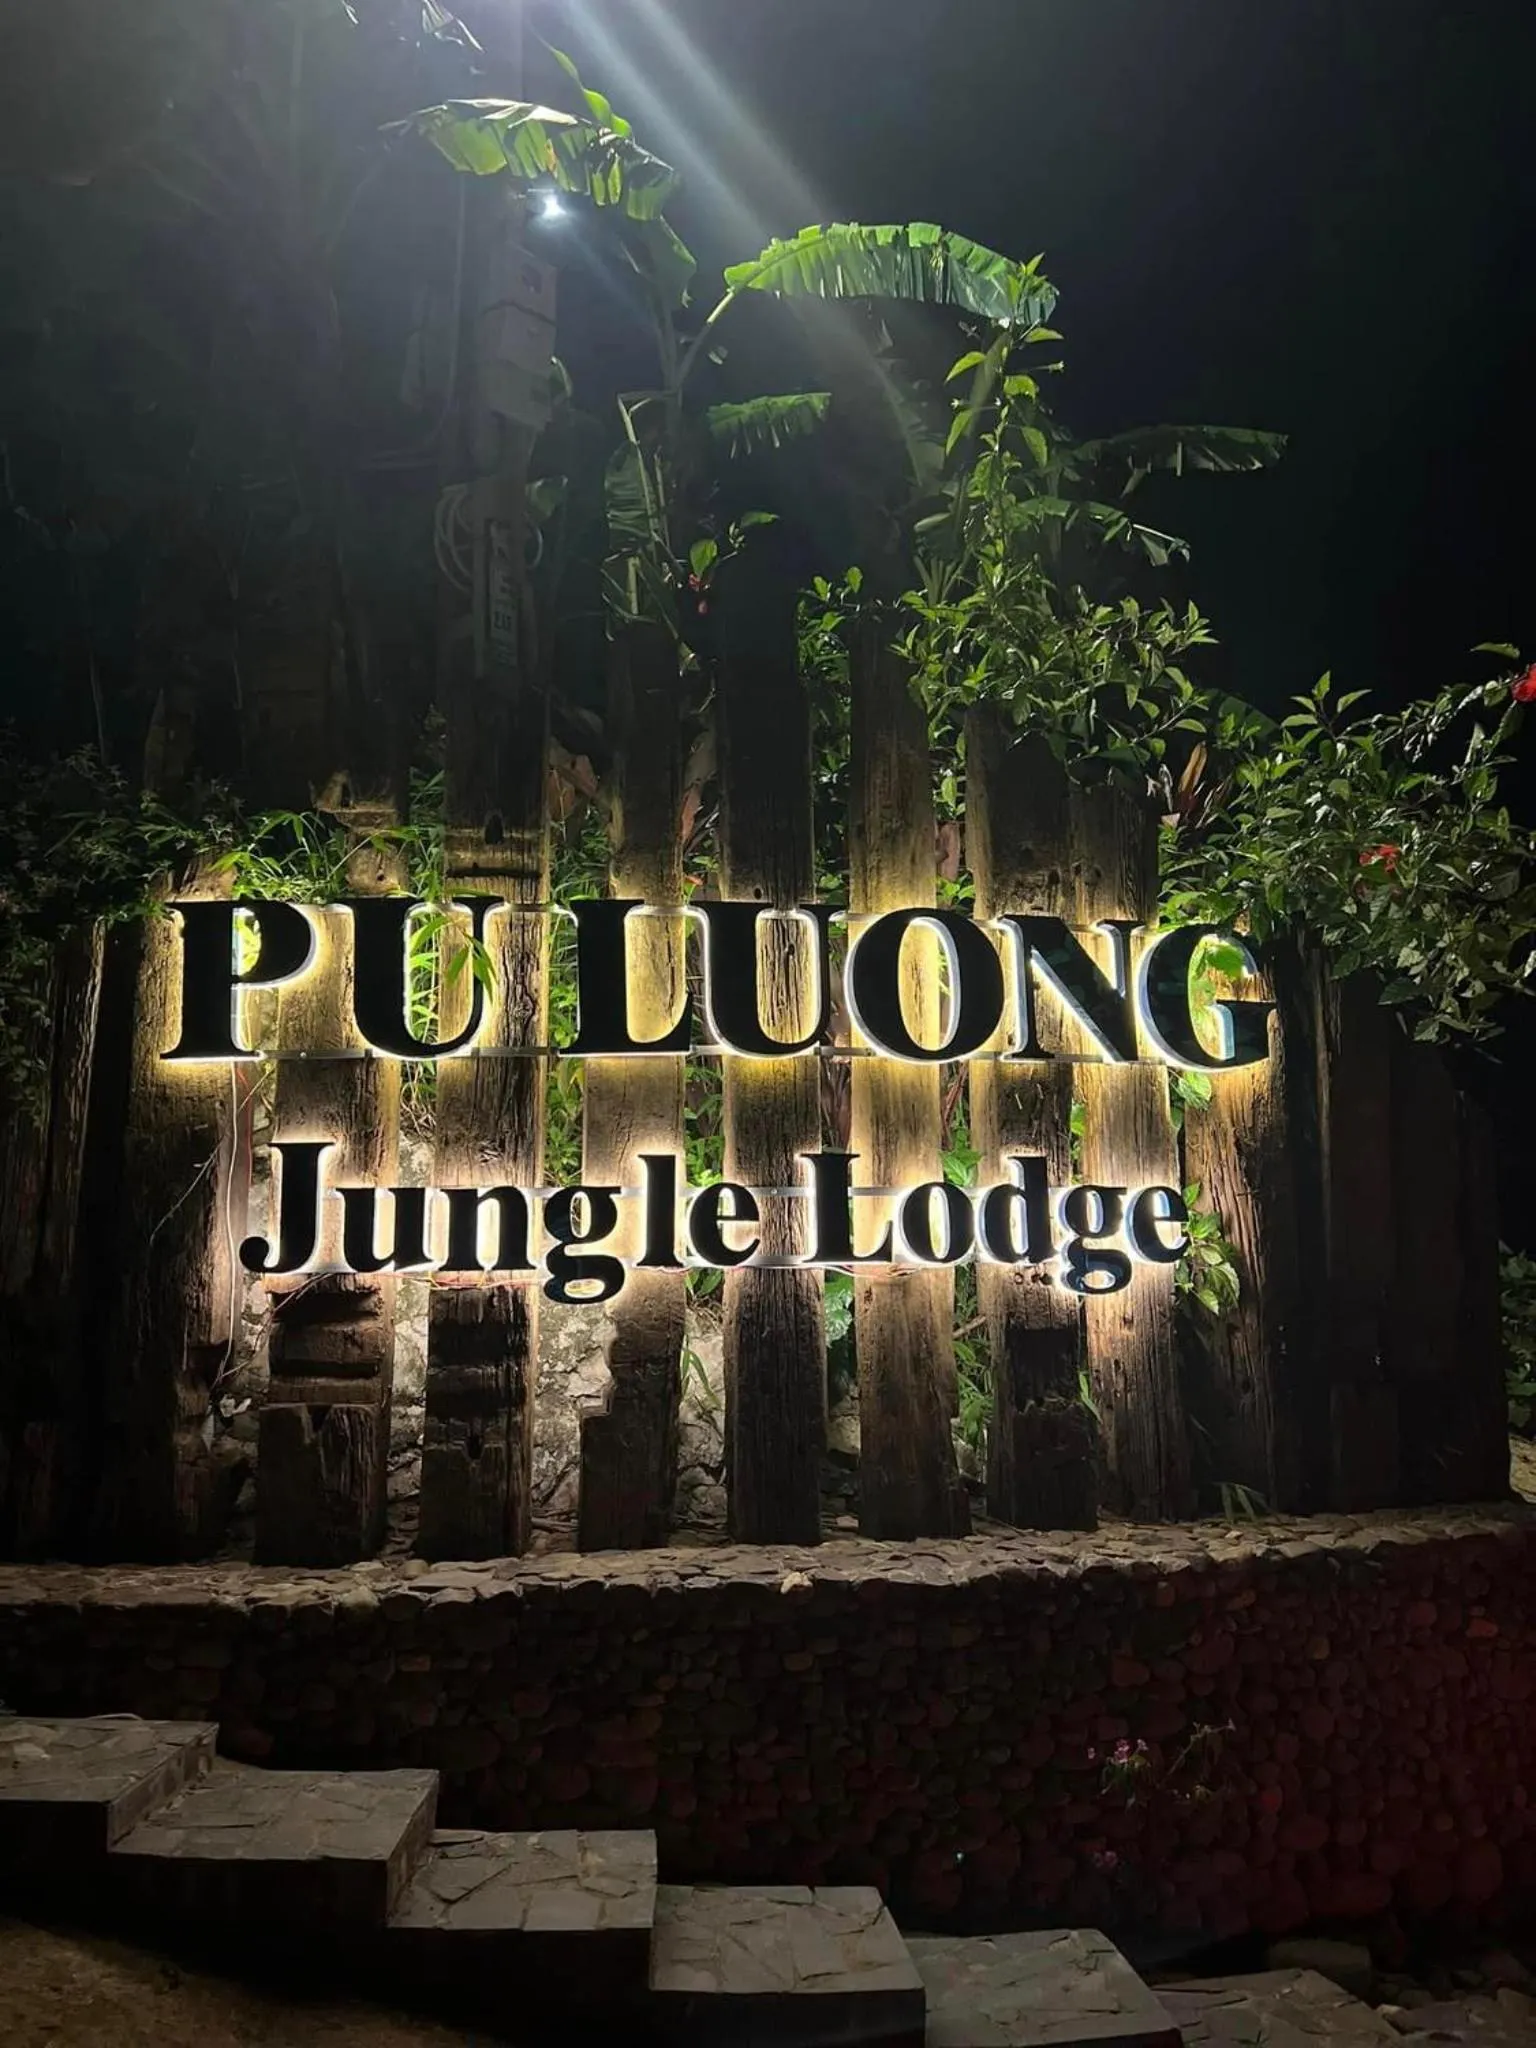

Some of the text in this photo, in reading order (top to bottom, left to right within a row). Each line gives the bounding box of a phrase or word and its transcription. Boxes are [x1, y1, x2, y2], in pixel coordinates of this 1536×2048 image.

[160, 896, 1278, 1068] PU LUONG
[239, 1142, 1189, 1304] Jungle Lodge
